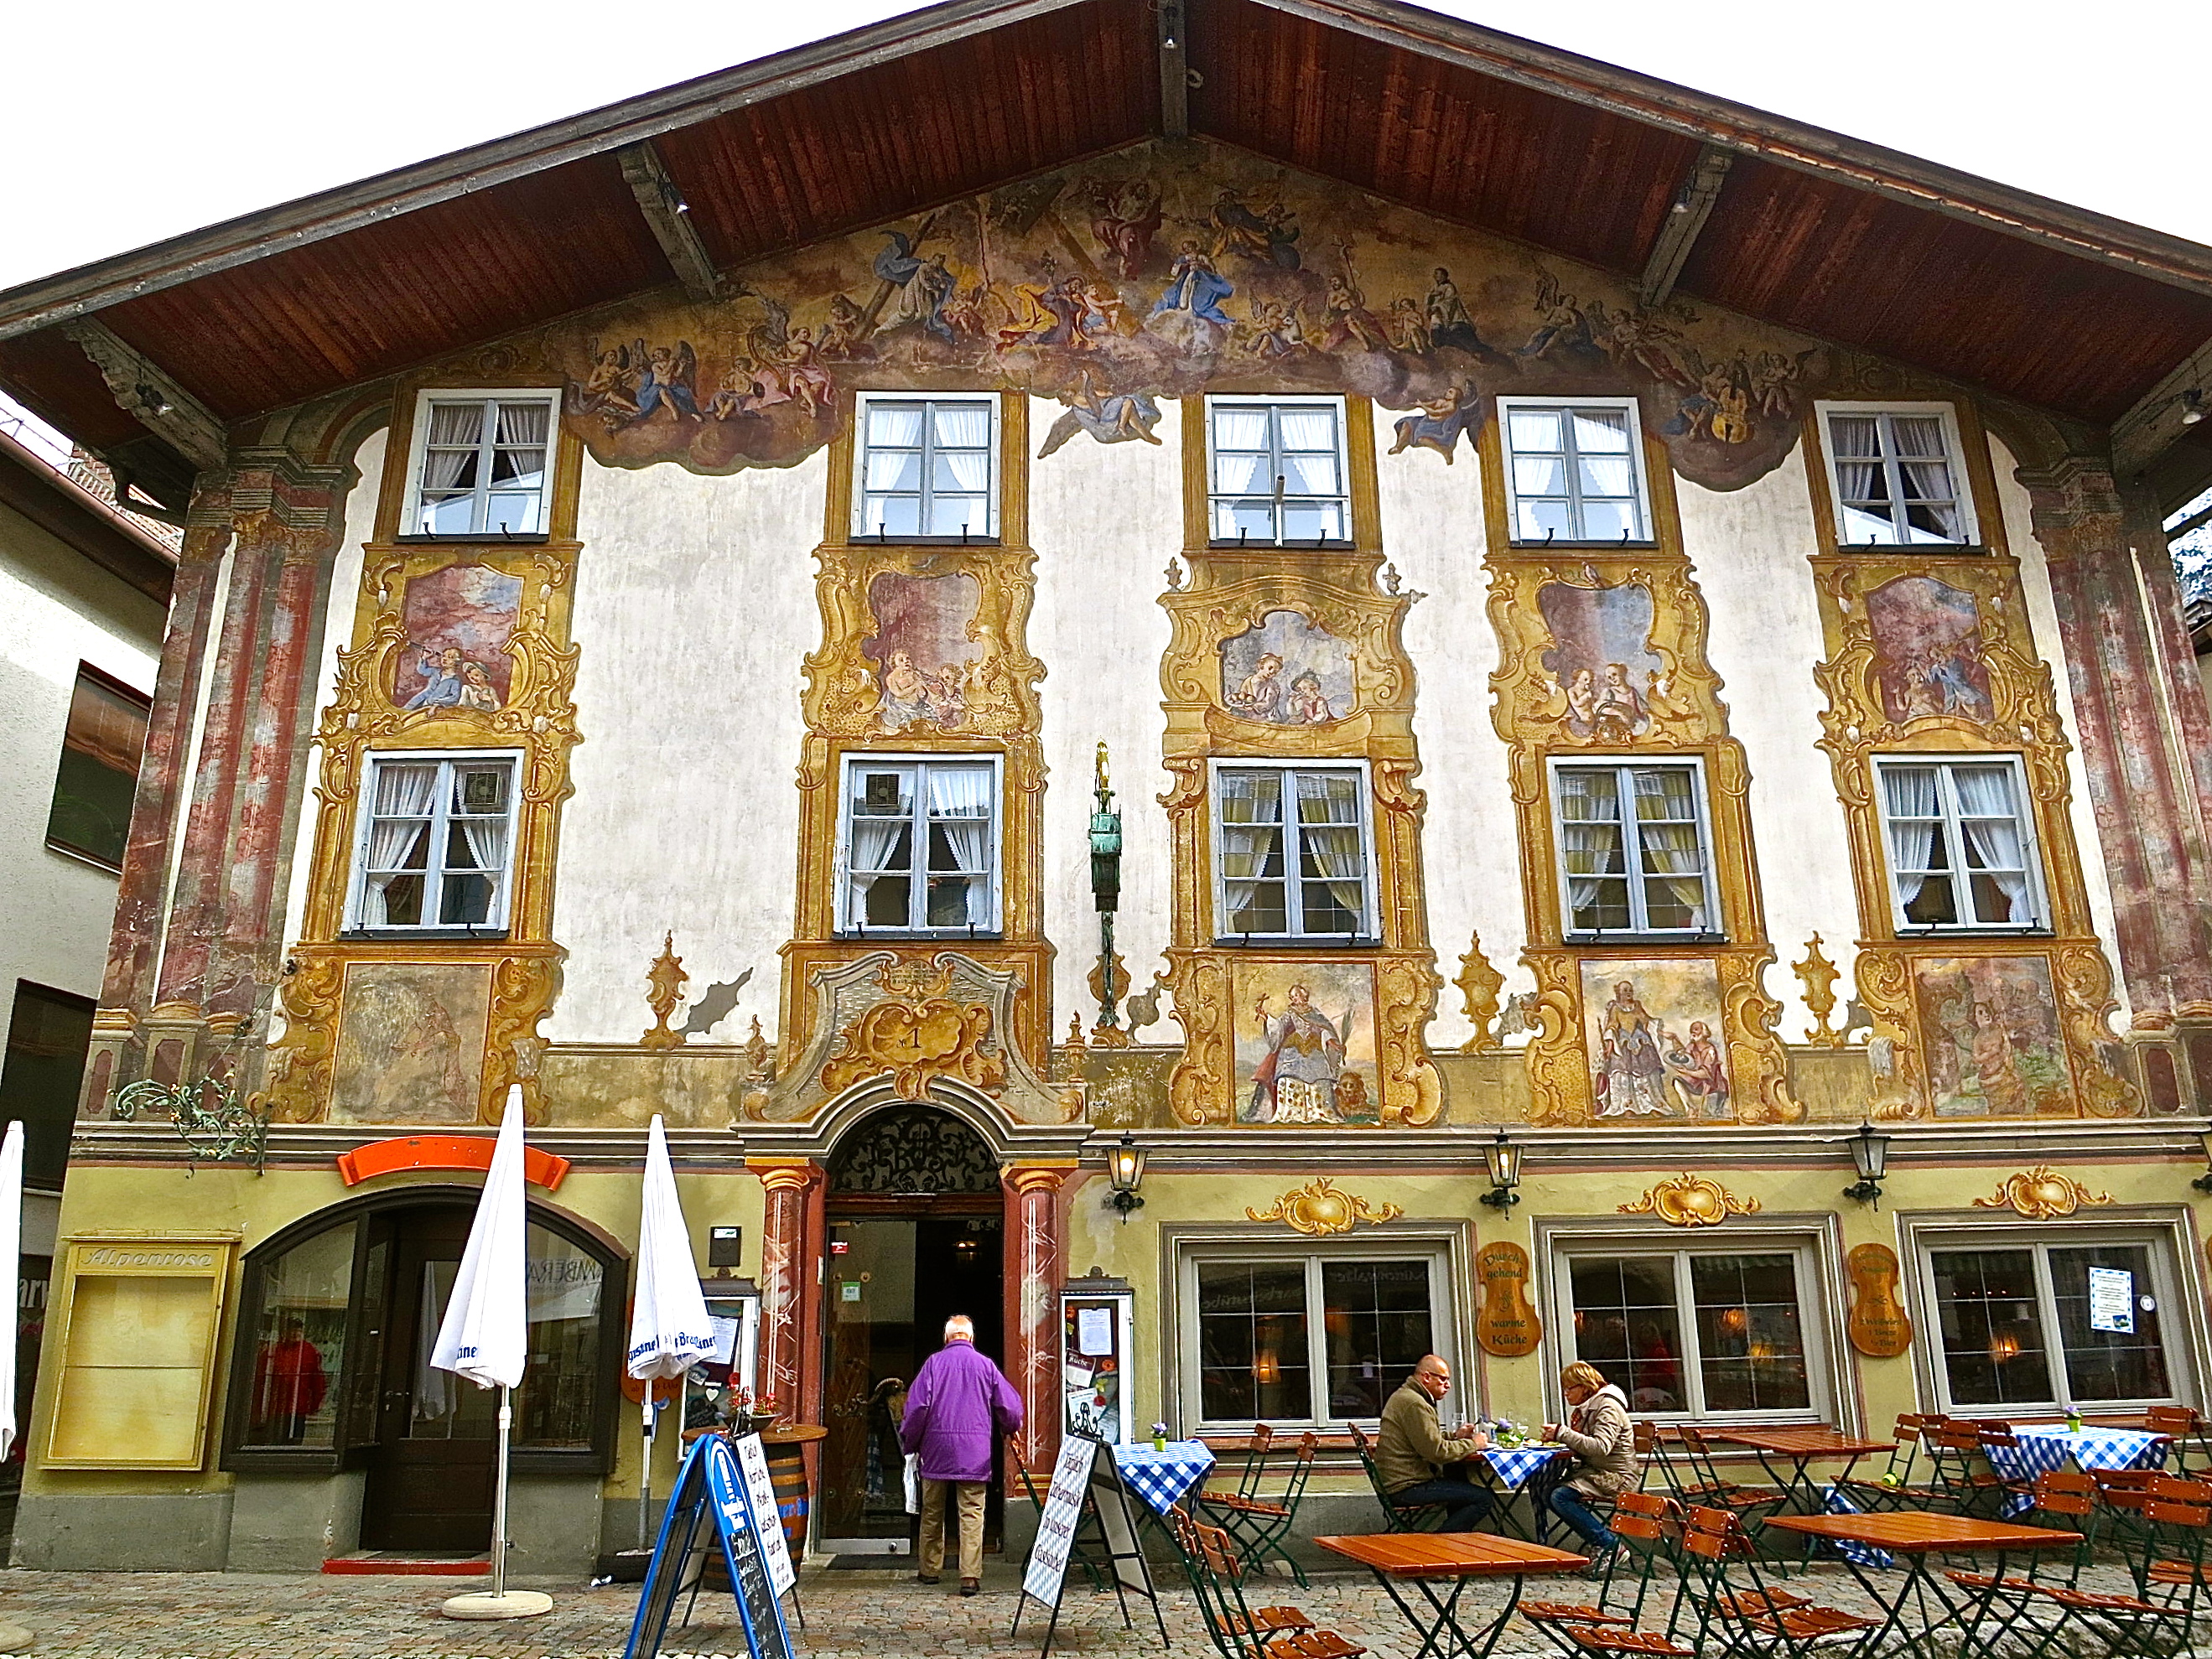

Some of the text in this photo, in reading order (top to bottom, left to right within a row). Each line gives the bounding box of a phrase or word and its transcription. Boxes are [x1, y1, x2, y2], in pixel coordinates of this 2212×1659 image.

[80, 1247, 212, 1268] Alpenrose
[1487, 1267, 1523, 1280] gehend
[1491, 1319, 1526, 1328] warme
[1492, 1334, 1528, 1345] Küche
